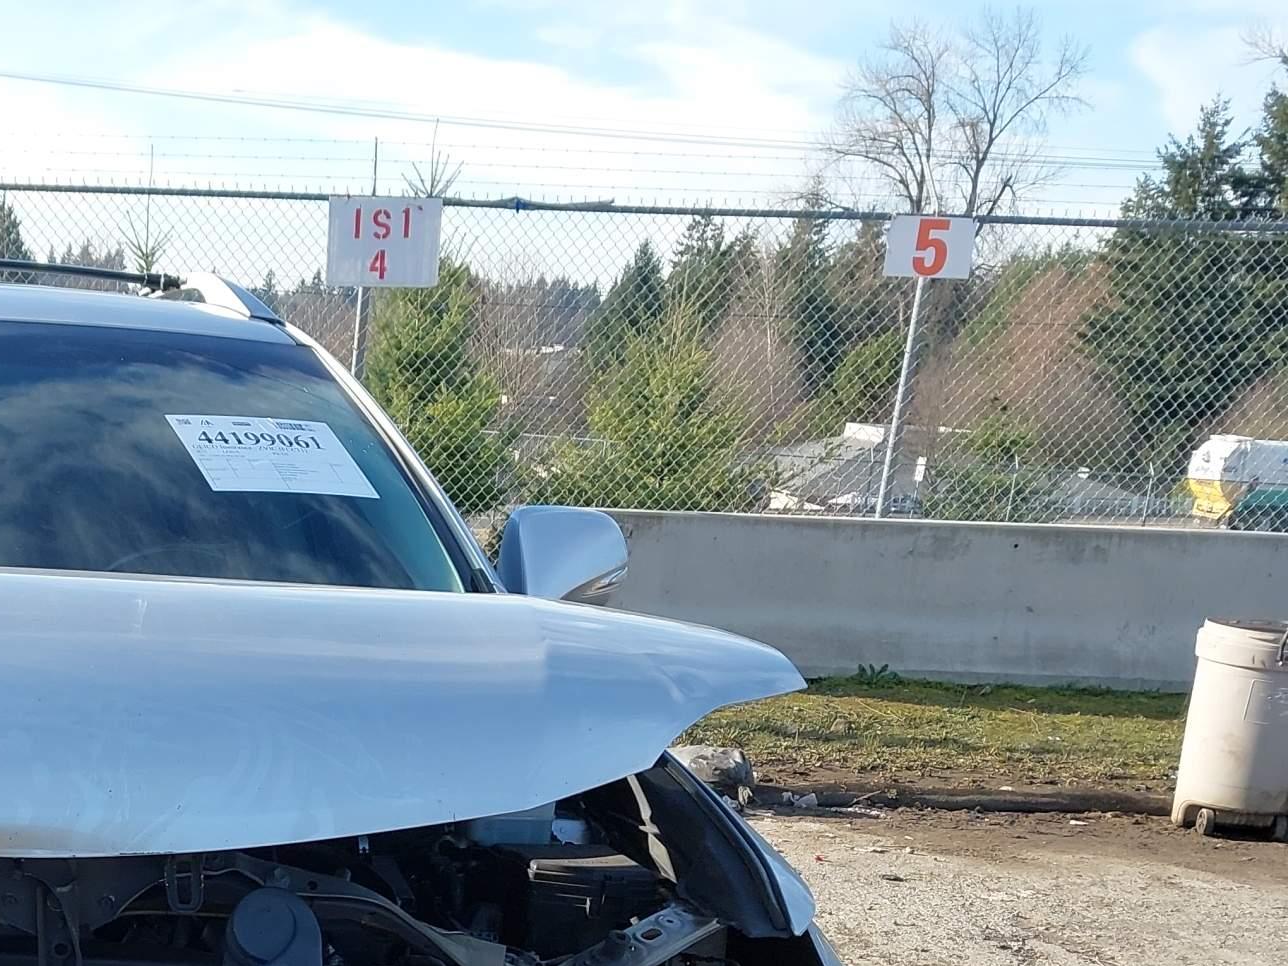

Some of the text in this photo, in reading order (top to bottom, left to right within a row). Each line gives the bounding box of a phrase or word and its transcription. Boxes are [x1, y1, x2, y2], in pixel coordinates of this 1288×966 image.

[354, 206, 412, 240] IS1
[912, 218, 949, 278] 5
[368, 249, 386, 280] 4
[197, 430, 327, 450] 44199061
